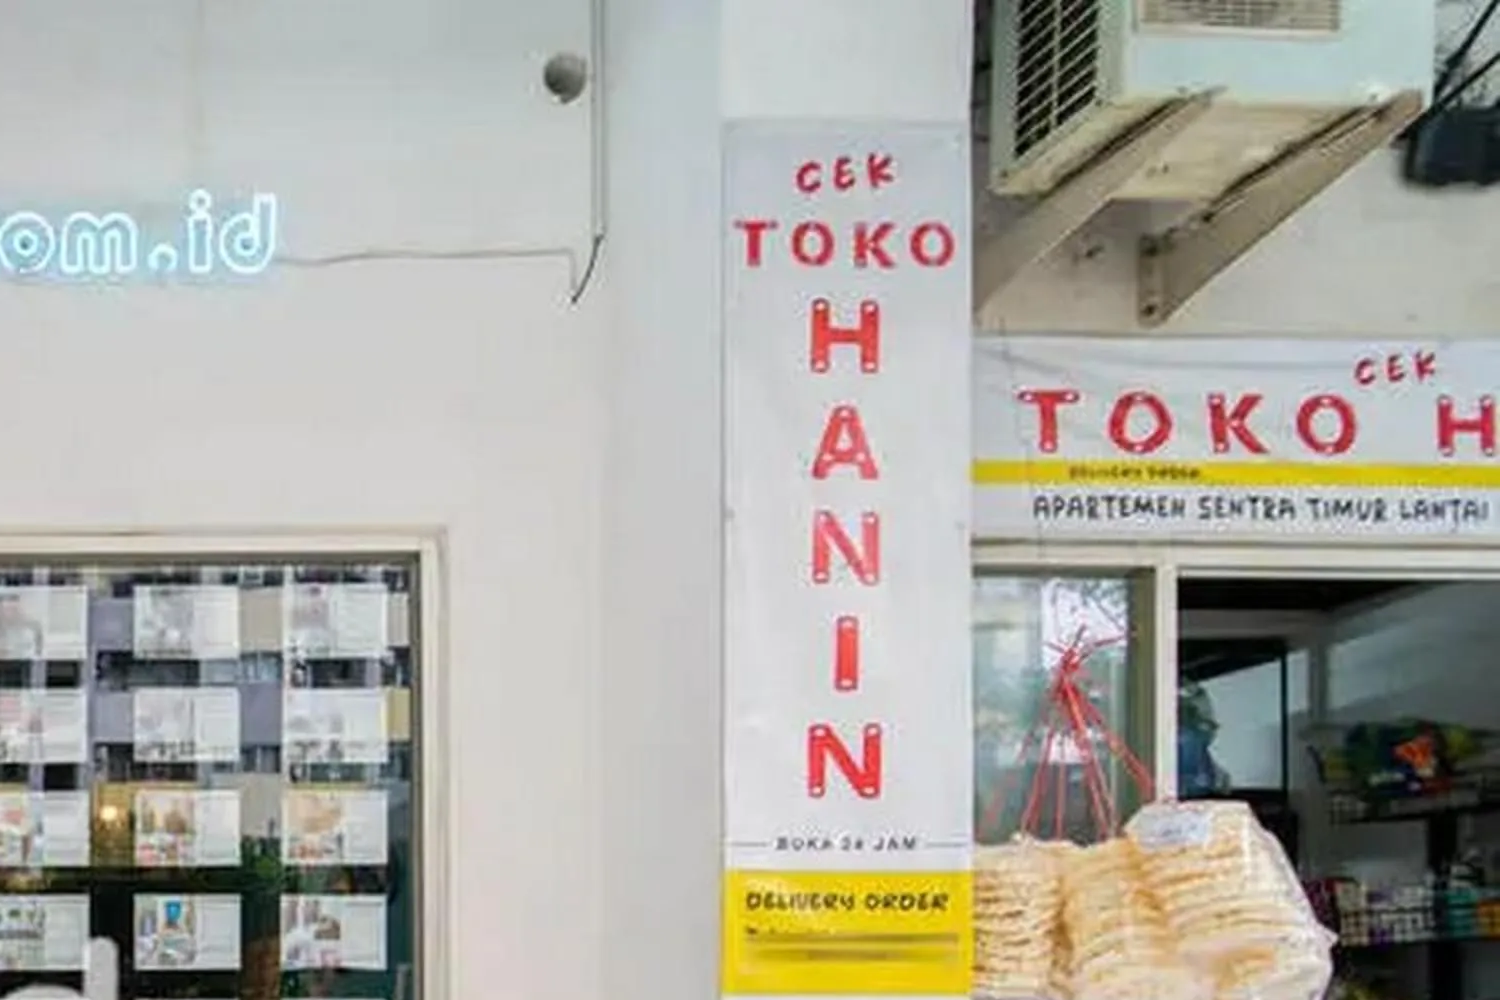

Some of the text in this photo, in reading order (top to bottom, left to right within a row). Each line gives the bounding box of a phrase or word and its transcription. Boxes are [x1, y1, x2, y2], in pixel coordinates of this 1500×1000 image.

[795, 152, 895, 194] CEK
[733, 219, 956, 270] TOKO
[1354, 350, 1438, 386] CEK
[1018, 390, 1359, 455] TOKO
[1033, 495, 1490, 522] APARTEMEN SENTRA TIMUR LANTAI
[806, 297, 883, 800] HANIN
[746, 892, 949, 911] DELIVERY ORDER
